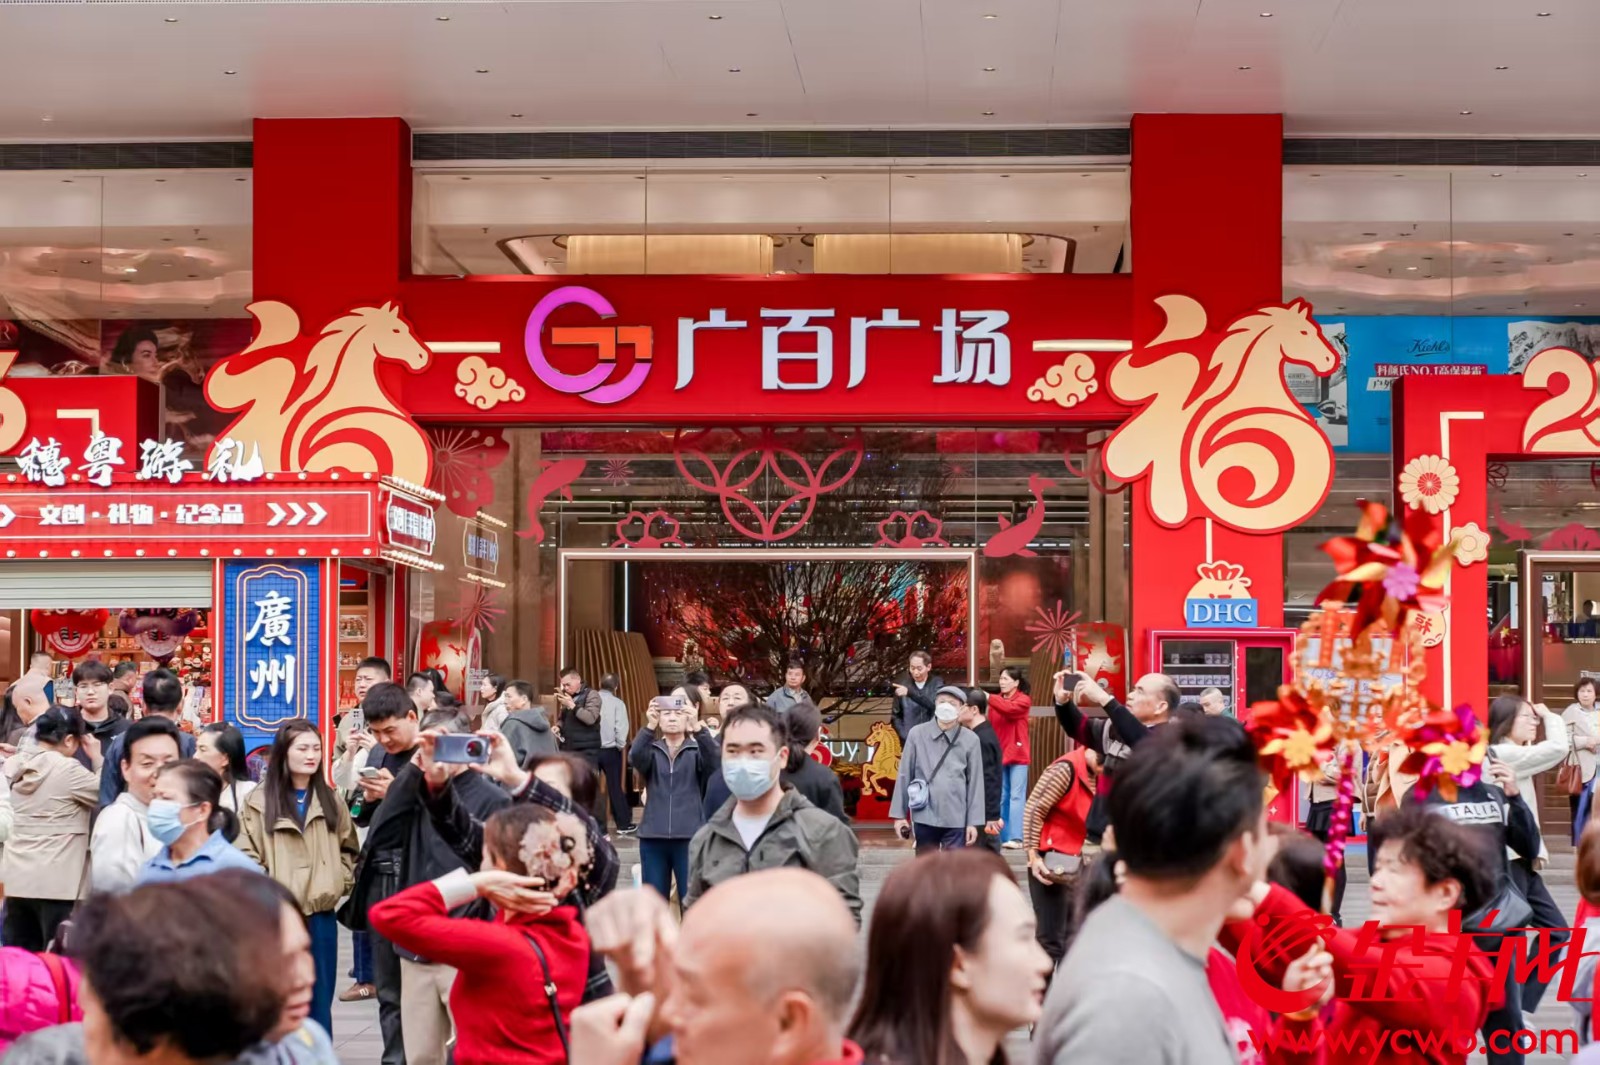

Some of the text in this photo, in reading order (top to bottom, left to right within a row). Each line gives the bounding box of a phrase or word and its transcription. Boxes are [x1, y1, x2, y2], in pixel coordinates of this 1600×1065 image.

[674, 307, 1012, 391] 广百广场
[1407, 339, 1451, 356] Kiehl's
[15, 430, 265, 487] 穗粤游礼
[1192, 603, 1252, 623] DHC
[245, 590, 296, 704] 廣州
